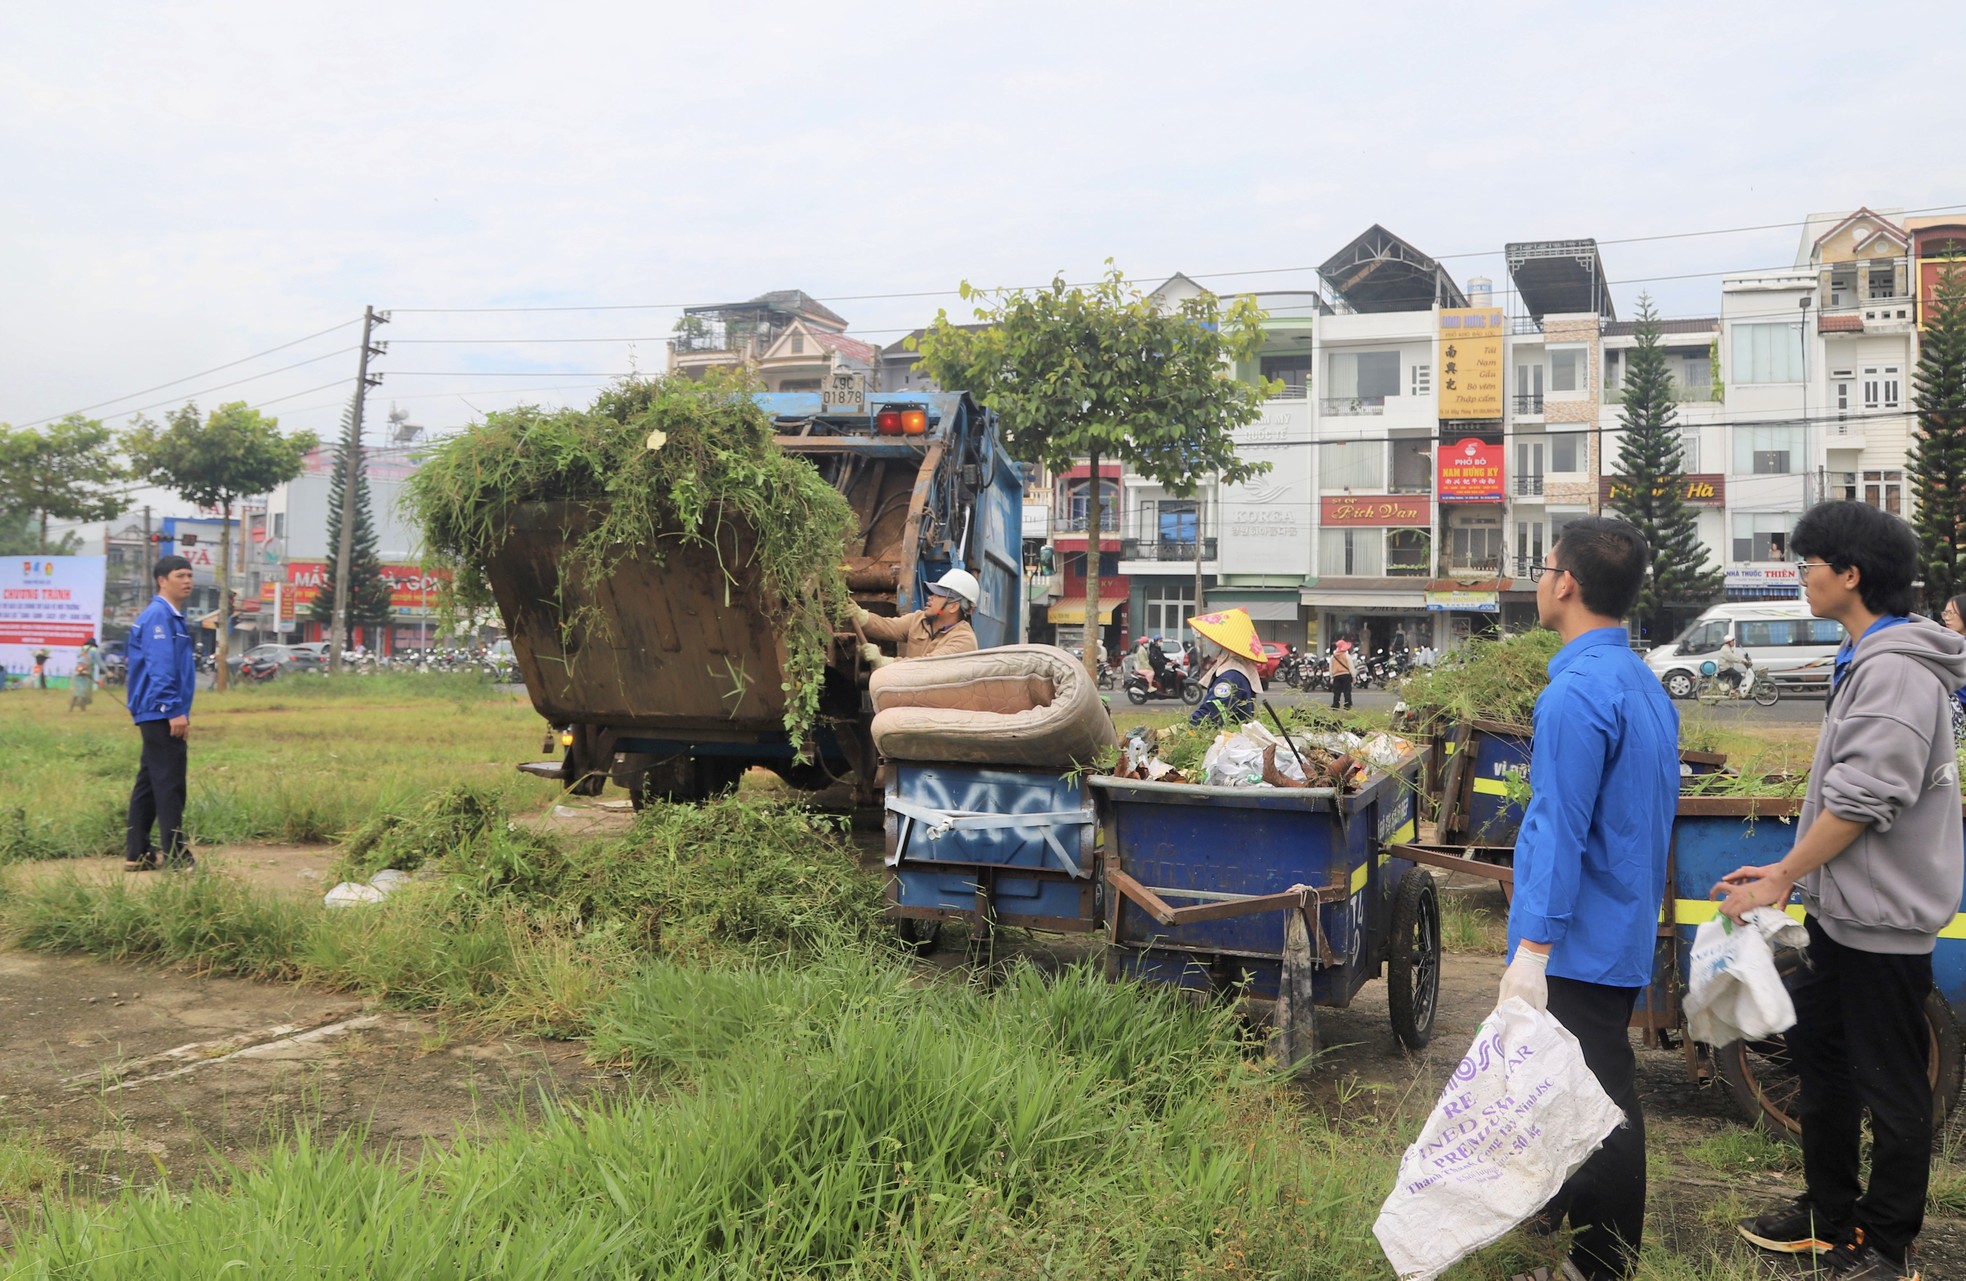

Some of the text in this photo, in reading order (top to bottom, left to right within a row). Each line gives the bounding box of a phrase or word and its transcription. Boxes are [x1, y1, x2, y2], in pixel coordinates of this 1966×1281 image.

[833, 377, 854, 390] 49C
[823, 391, 862, 404] 01878
[1443, 468, 1460, 477] NAM
[1234, 511, 1295, 523] KOREA
[1513, 1093, 1538, 1117] Ninh
[1535, 1076, 1555, 1097] JSC
[1512, 1135, 1529, 1155] 50
